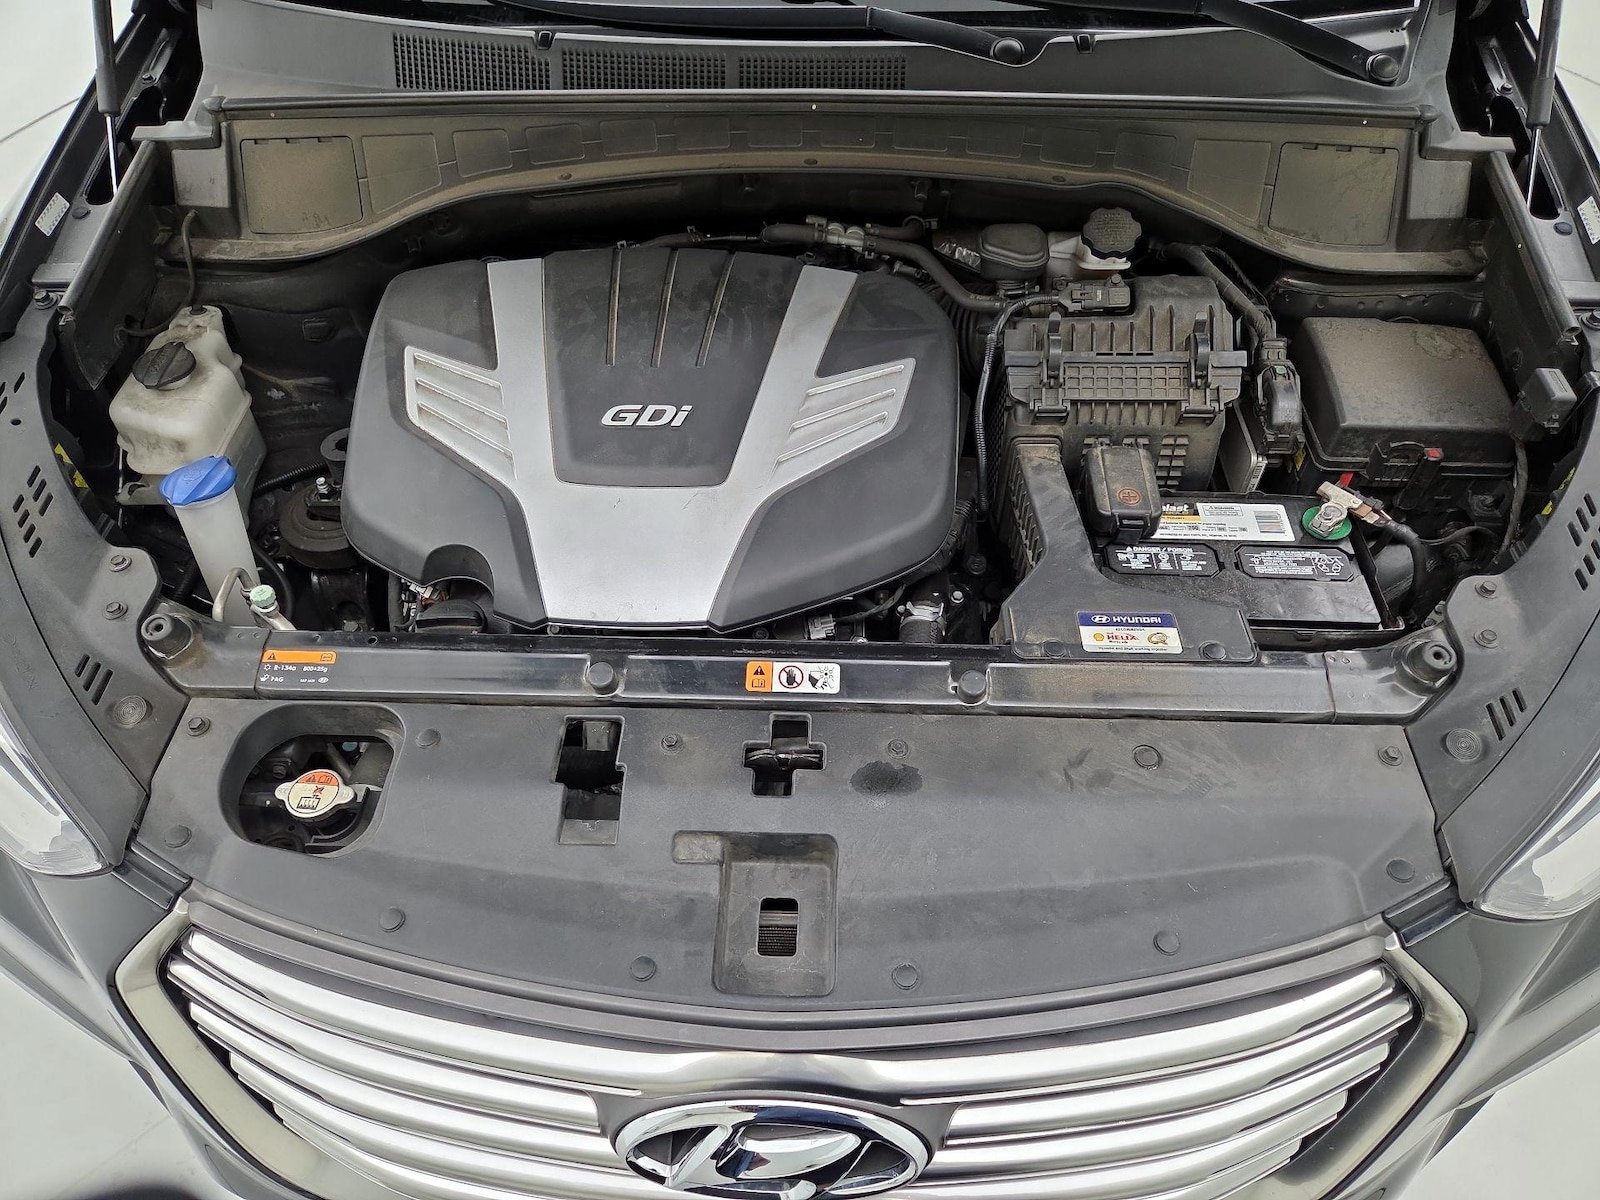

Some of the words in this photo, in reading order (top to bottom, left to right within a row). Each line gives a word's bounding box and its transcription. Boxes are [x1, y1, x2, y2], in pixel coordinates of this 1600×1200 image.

[601, 404, 693, 427] GDi
[1113, 616, 1162, 624] HYUNDAI
[1107, 633, 1138, 641] HELIX
